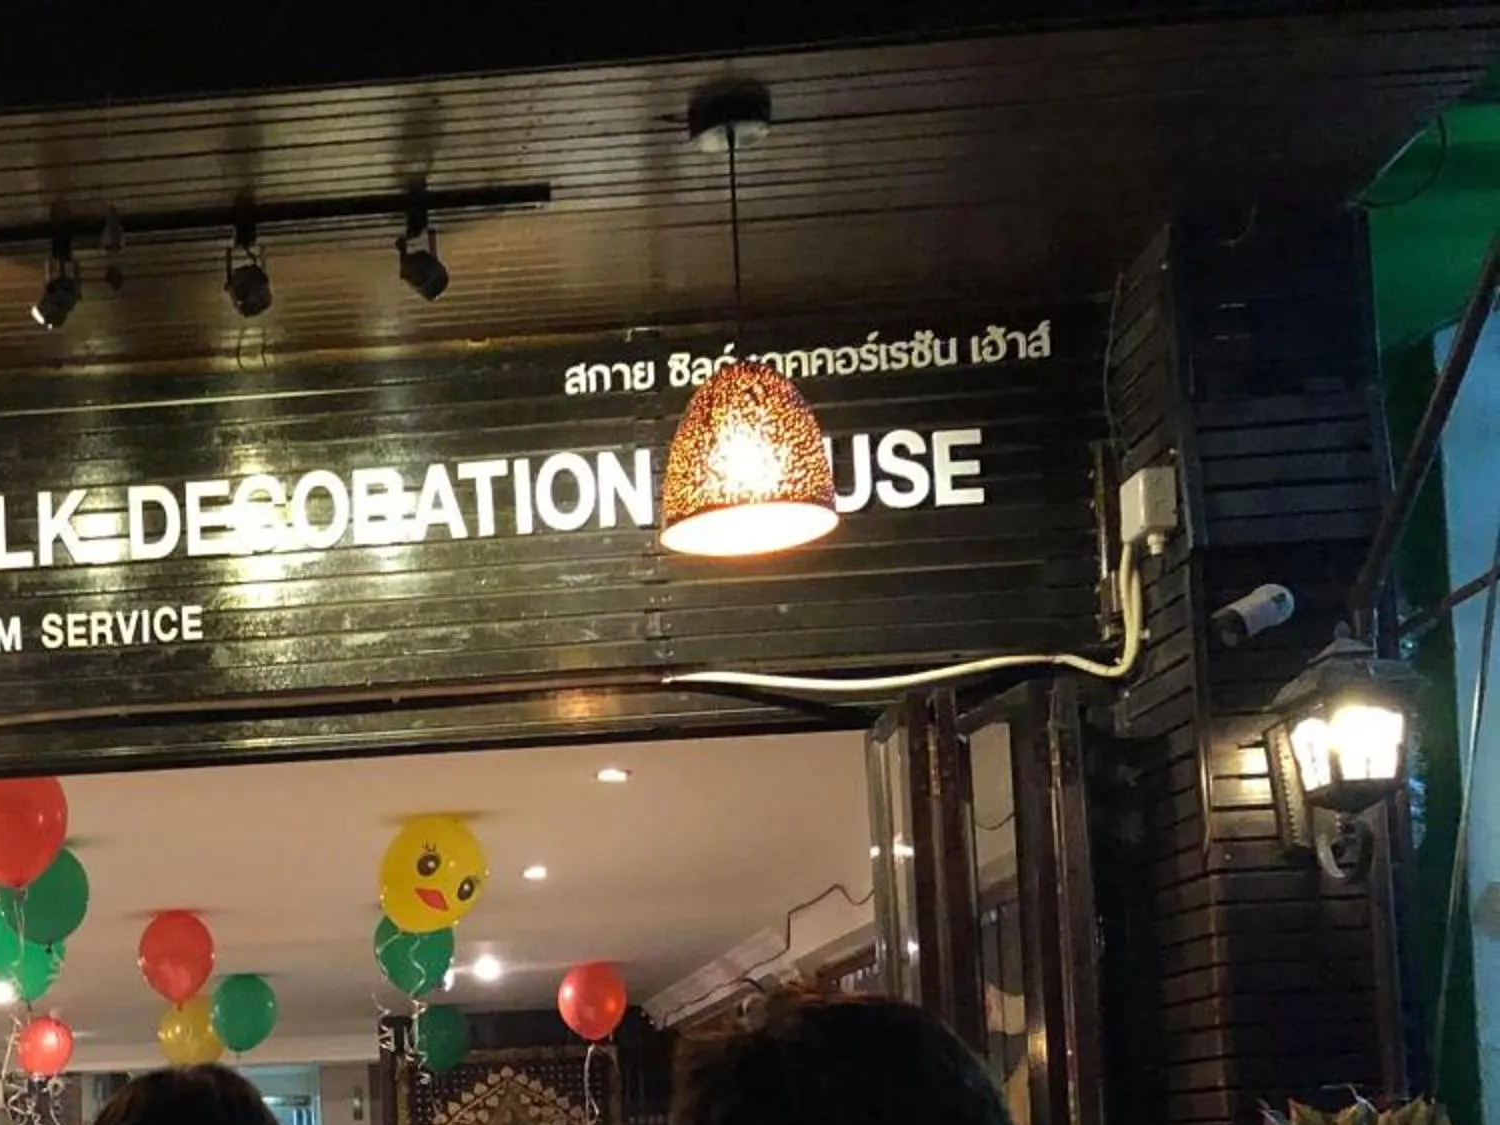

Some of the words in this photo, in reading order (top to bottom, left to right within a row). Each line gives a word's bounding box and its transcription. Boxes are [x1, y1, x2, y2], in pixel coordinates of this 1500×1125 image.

[564, 360, 655, 396] สกาย
[128, 446, 653, 561] DECORATION
[41, 605, 204, 650] SERVICE
